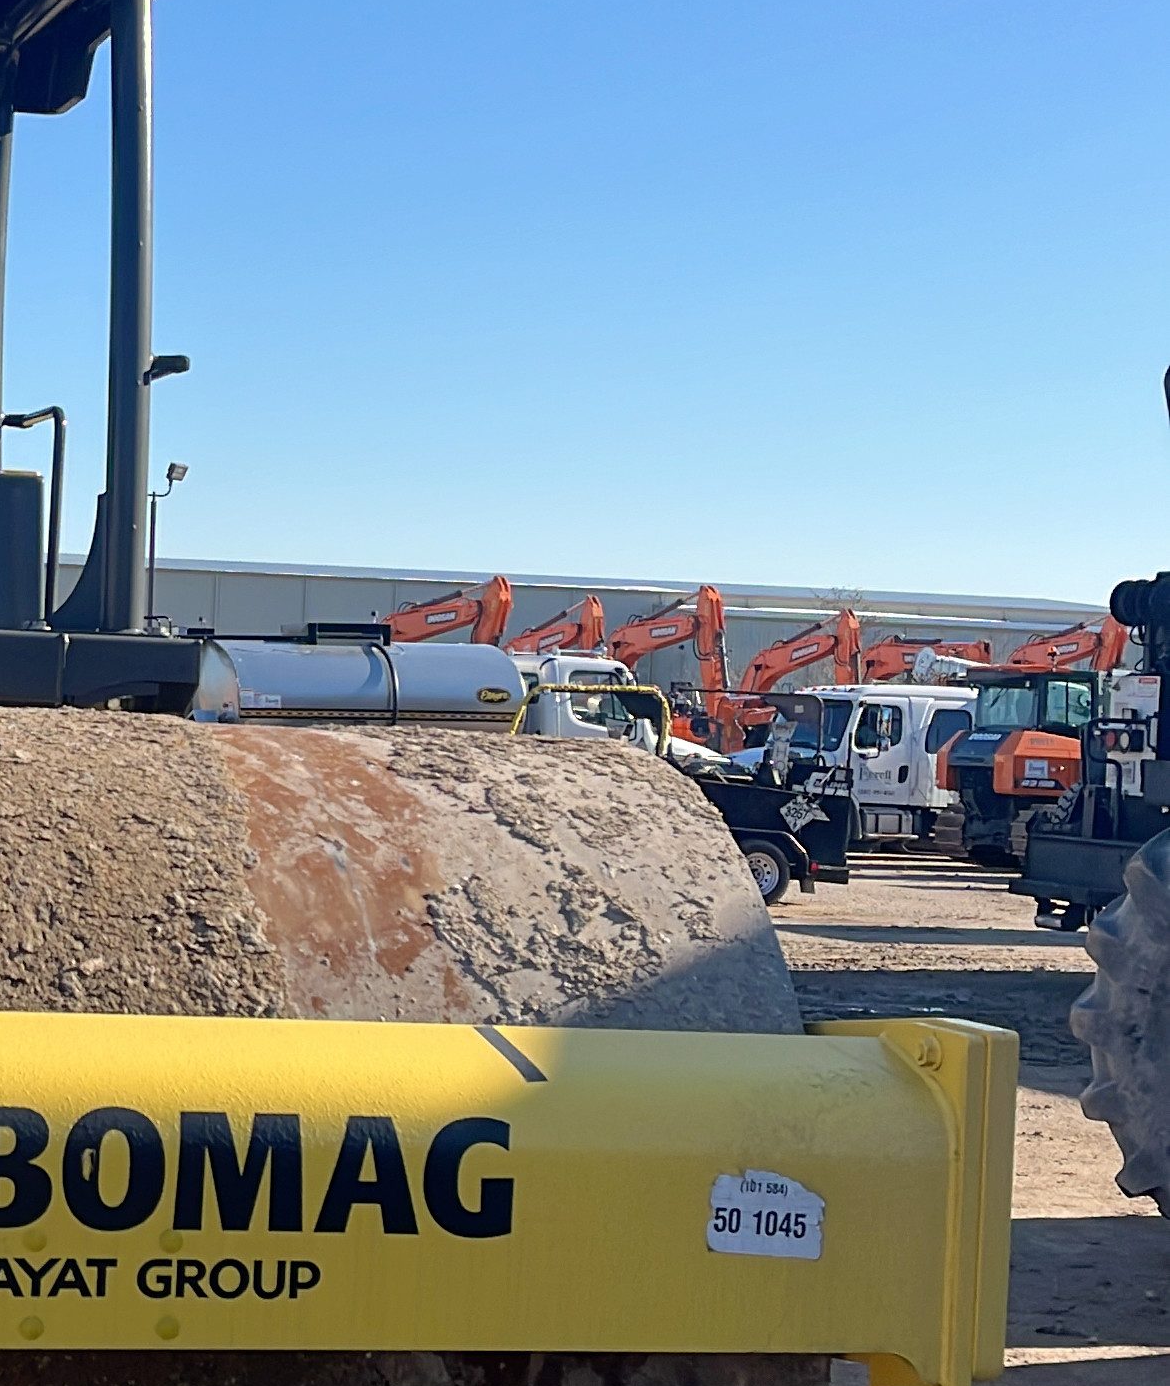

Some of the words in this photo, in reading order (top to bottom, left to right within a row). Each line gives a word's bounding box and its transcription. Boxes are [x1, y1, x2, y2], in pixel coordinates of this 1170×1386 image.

[714, 1207, 741, 1233] 50
[753, 1210, 806, 1238] 1045
[136, 1259, 321, 1300] GROUP
